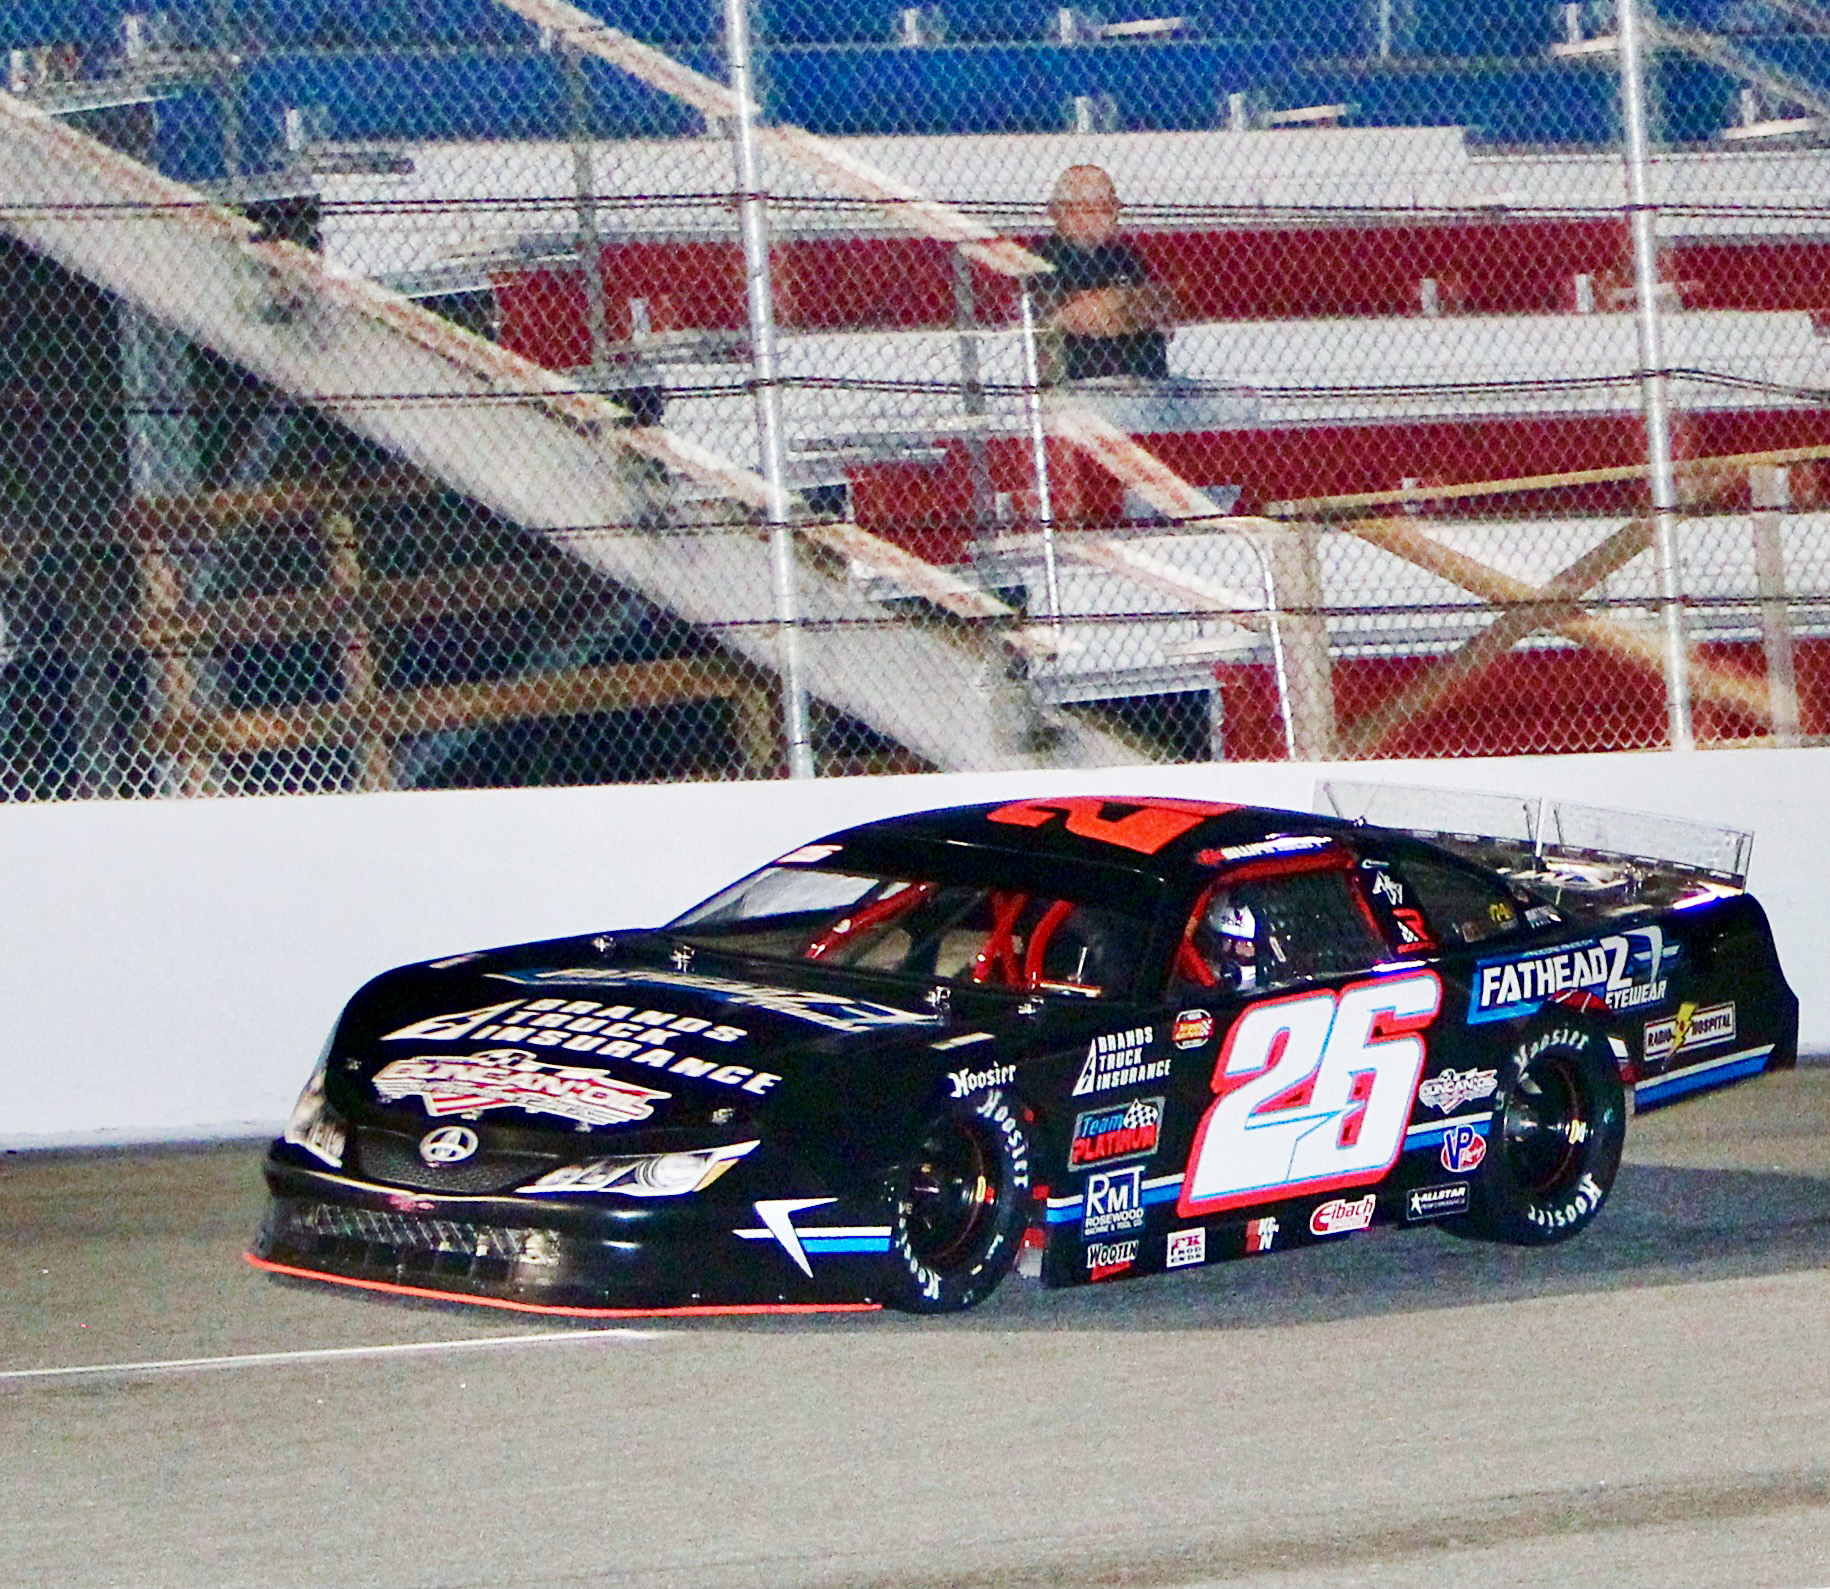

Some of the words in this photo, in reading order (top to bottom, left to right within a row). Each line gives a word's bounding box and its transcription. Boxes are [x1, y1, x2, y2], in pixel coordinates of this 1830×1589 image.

[1481, 934, 1633, 1006] FATHEADZ
[503, 1011, 682, 1046] TRUCK
[523, 998, 749, 1043] BRANDS
[1097, 1026, 1153, 1053] BRANDS
[470, 1026, 783, 1095] INSURANCE
[1096, 1059, 1172, 1091] INSURANCE
[1099, 1047, 1143, 1072] TRUCK
[948, 1061, 1016, 1098] Hoosier
[1186, 971, 1442, 1206] 26
[976, 1090, 1029, 1189] Hoosier
[1072, 1123, 1158, 1165] PLATINUM
[1081, 1113, 1125, 1137] Team
[1445, 1126, 1474, 1170] VP
[1086, 1165, 1146, 1217] RMT
[1420, 1187, 1466, 1202] ALLSTAR
[1527, 1172, 1603, 1228] Hoosier
[1085, 1207, 1144, 1229] ROSEWOOD
[1312, 1196, 1374, 1232] Eibach
